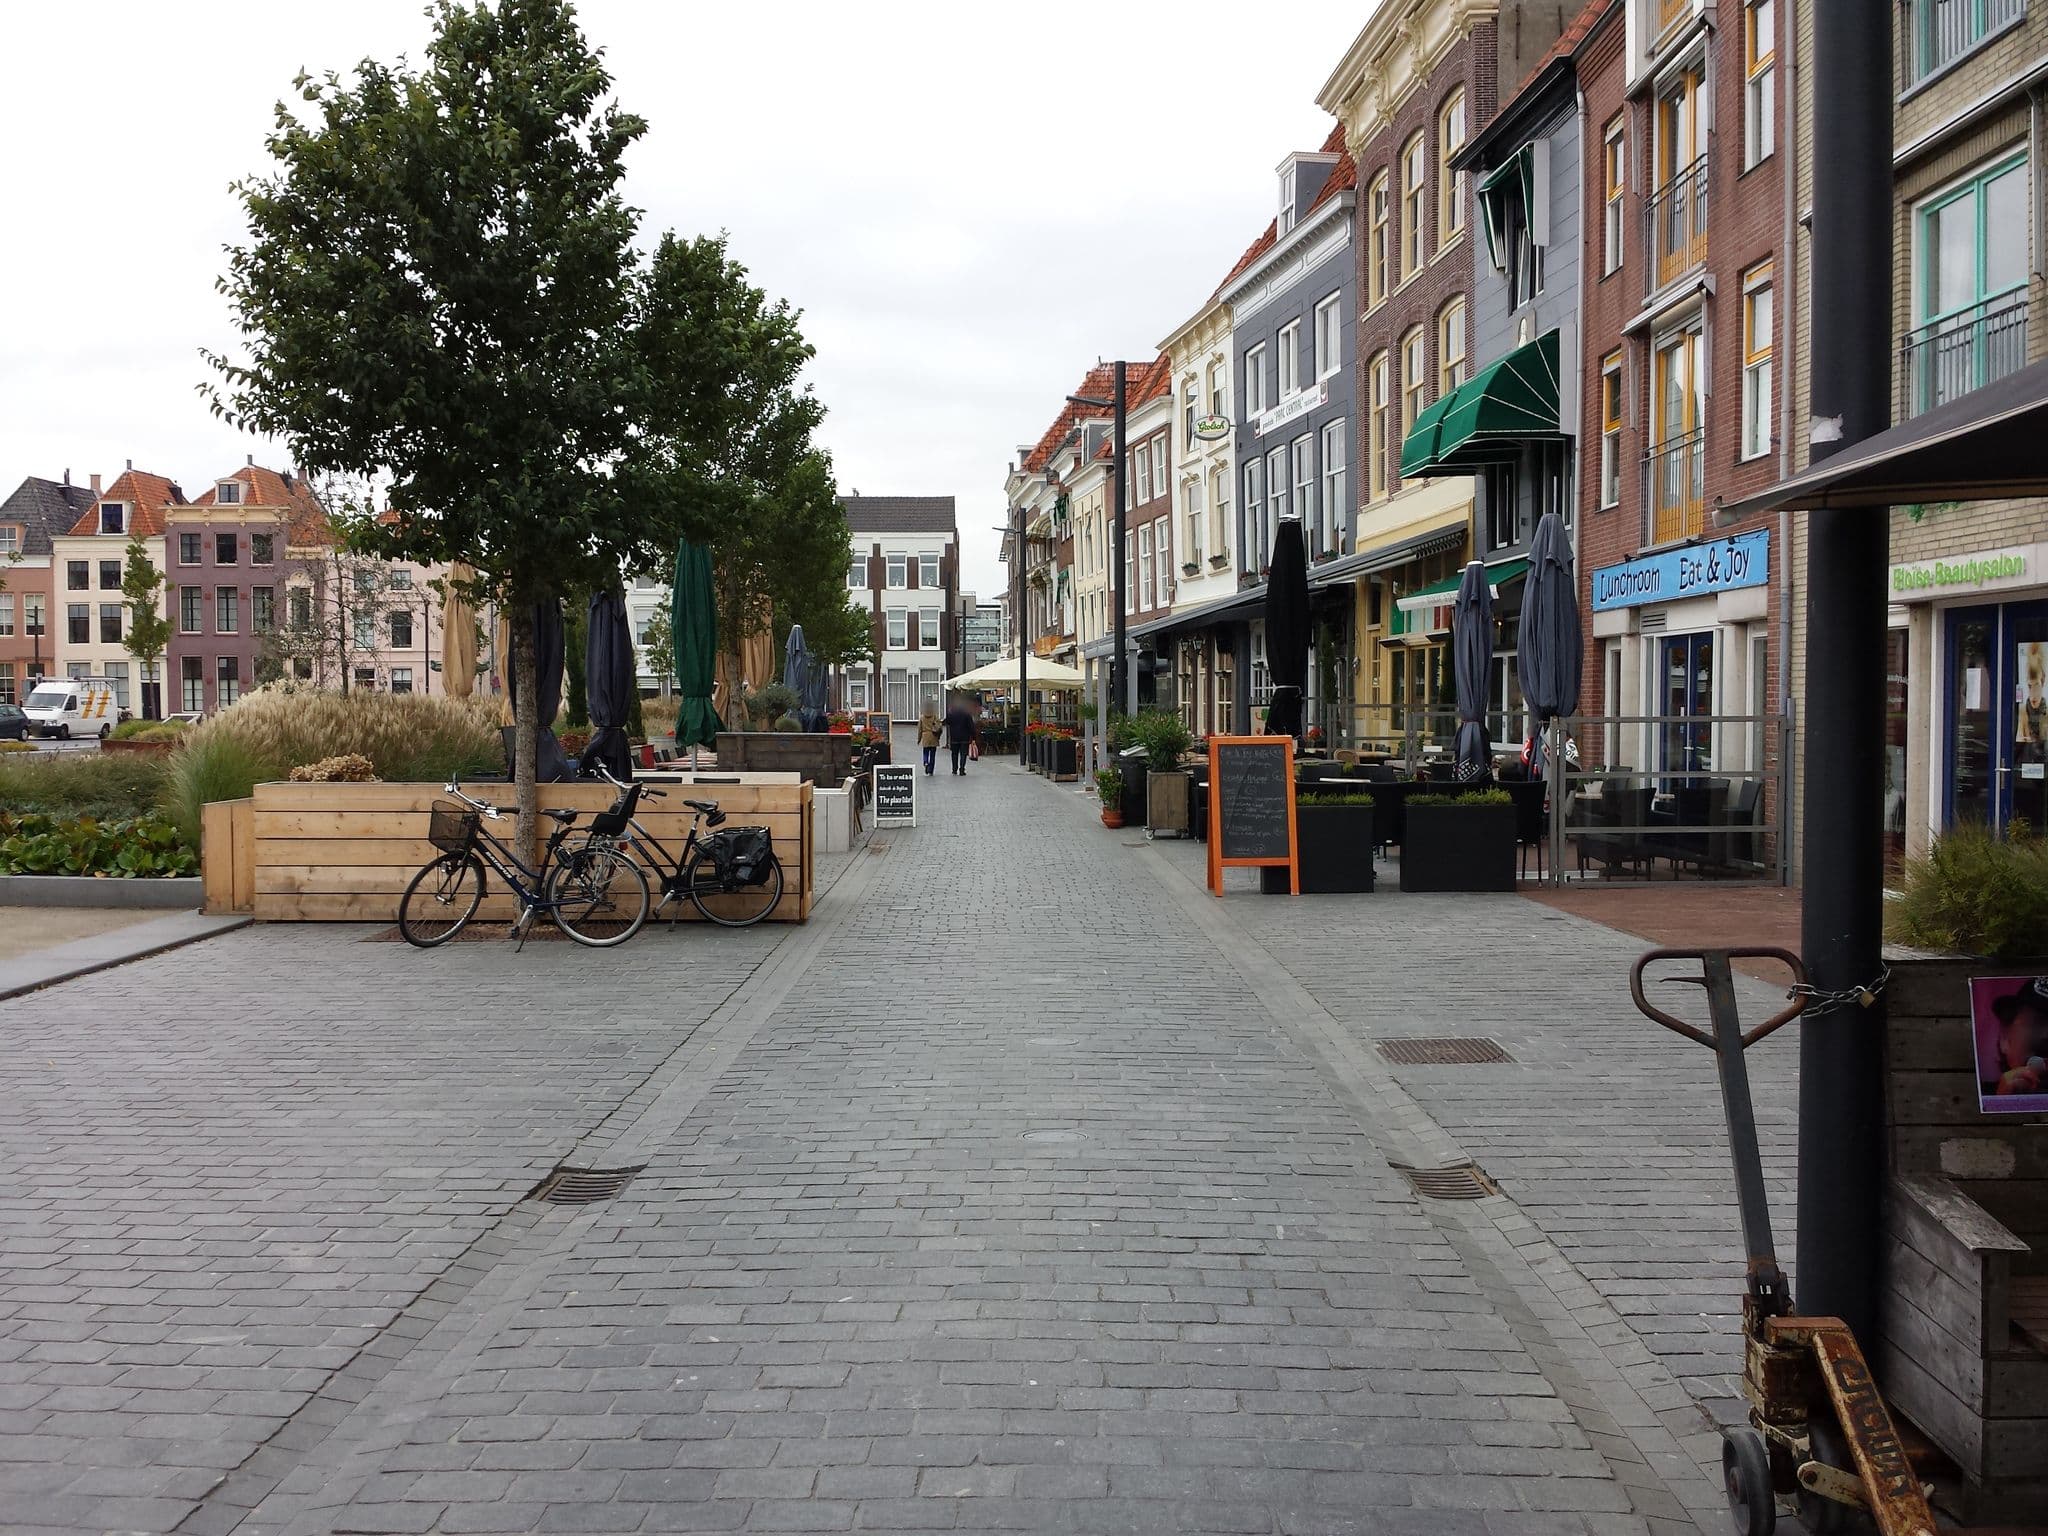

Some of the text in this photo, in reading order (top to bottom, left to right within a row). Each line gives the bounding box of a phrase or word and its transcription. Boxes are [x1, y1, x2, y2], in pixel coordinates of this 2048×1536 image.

[1197, 420, 1225, 433] Grolsch
[1600, 546, 1750, 603] Lunchroom Eat & Joy
[1935, 553, 2026, 587] Beautysalon
